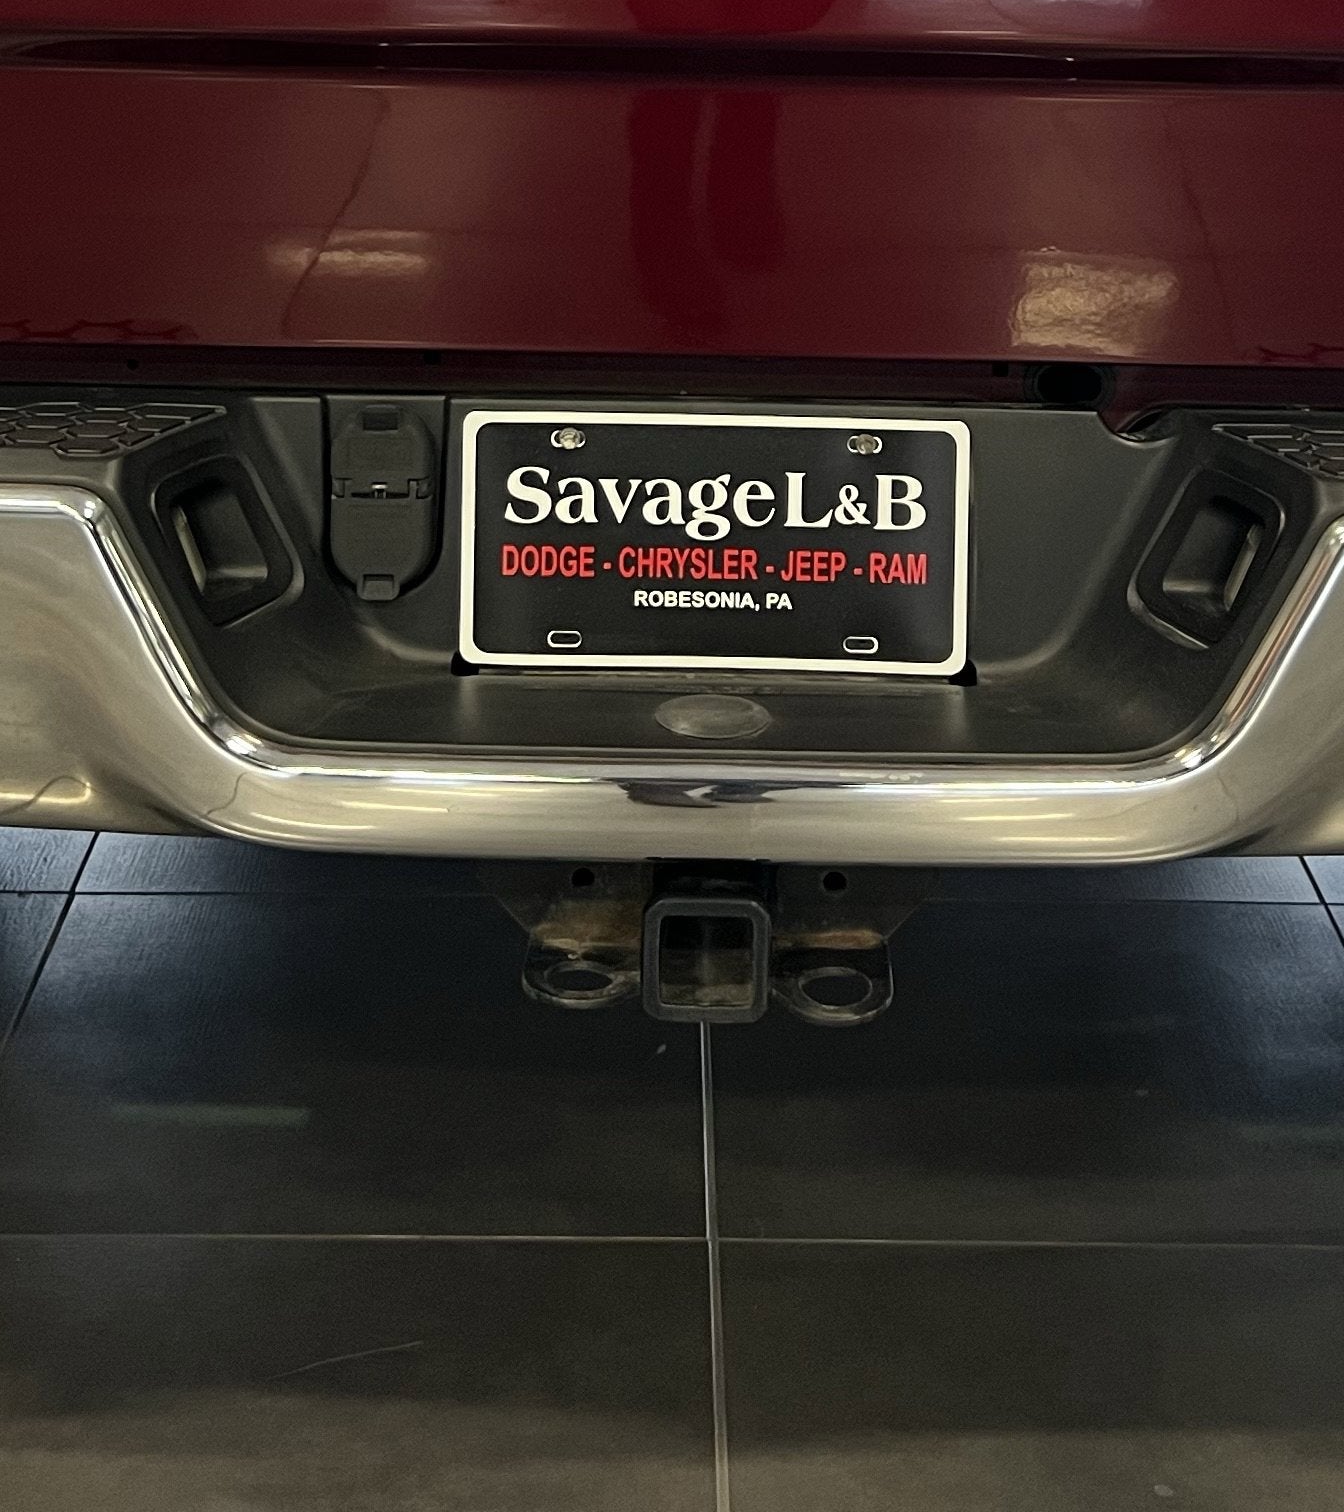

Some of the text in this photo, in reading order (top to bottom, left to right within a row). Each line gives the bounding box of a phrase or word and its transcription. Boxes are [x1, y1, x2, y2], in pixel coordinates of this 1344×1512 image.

[501, 545, 595, 578] DODGE
[618, 547, 758, 581] CHRYSLER
[781, 550, 846, 583] JEEP
[869, 553, 928, 585] RAM
[634, 590, 793, 612] ROBESONIA, PA
